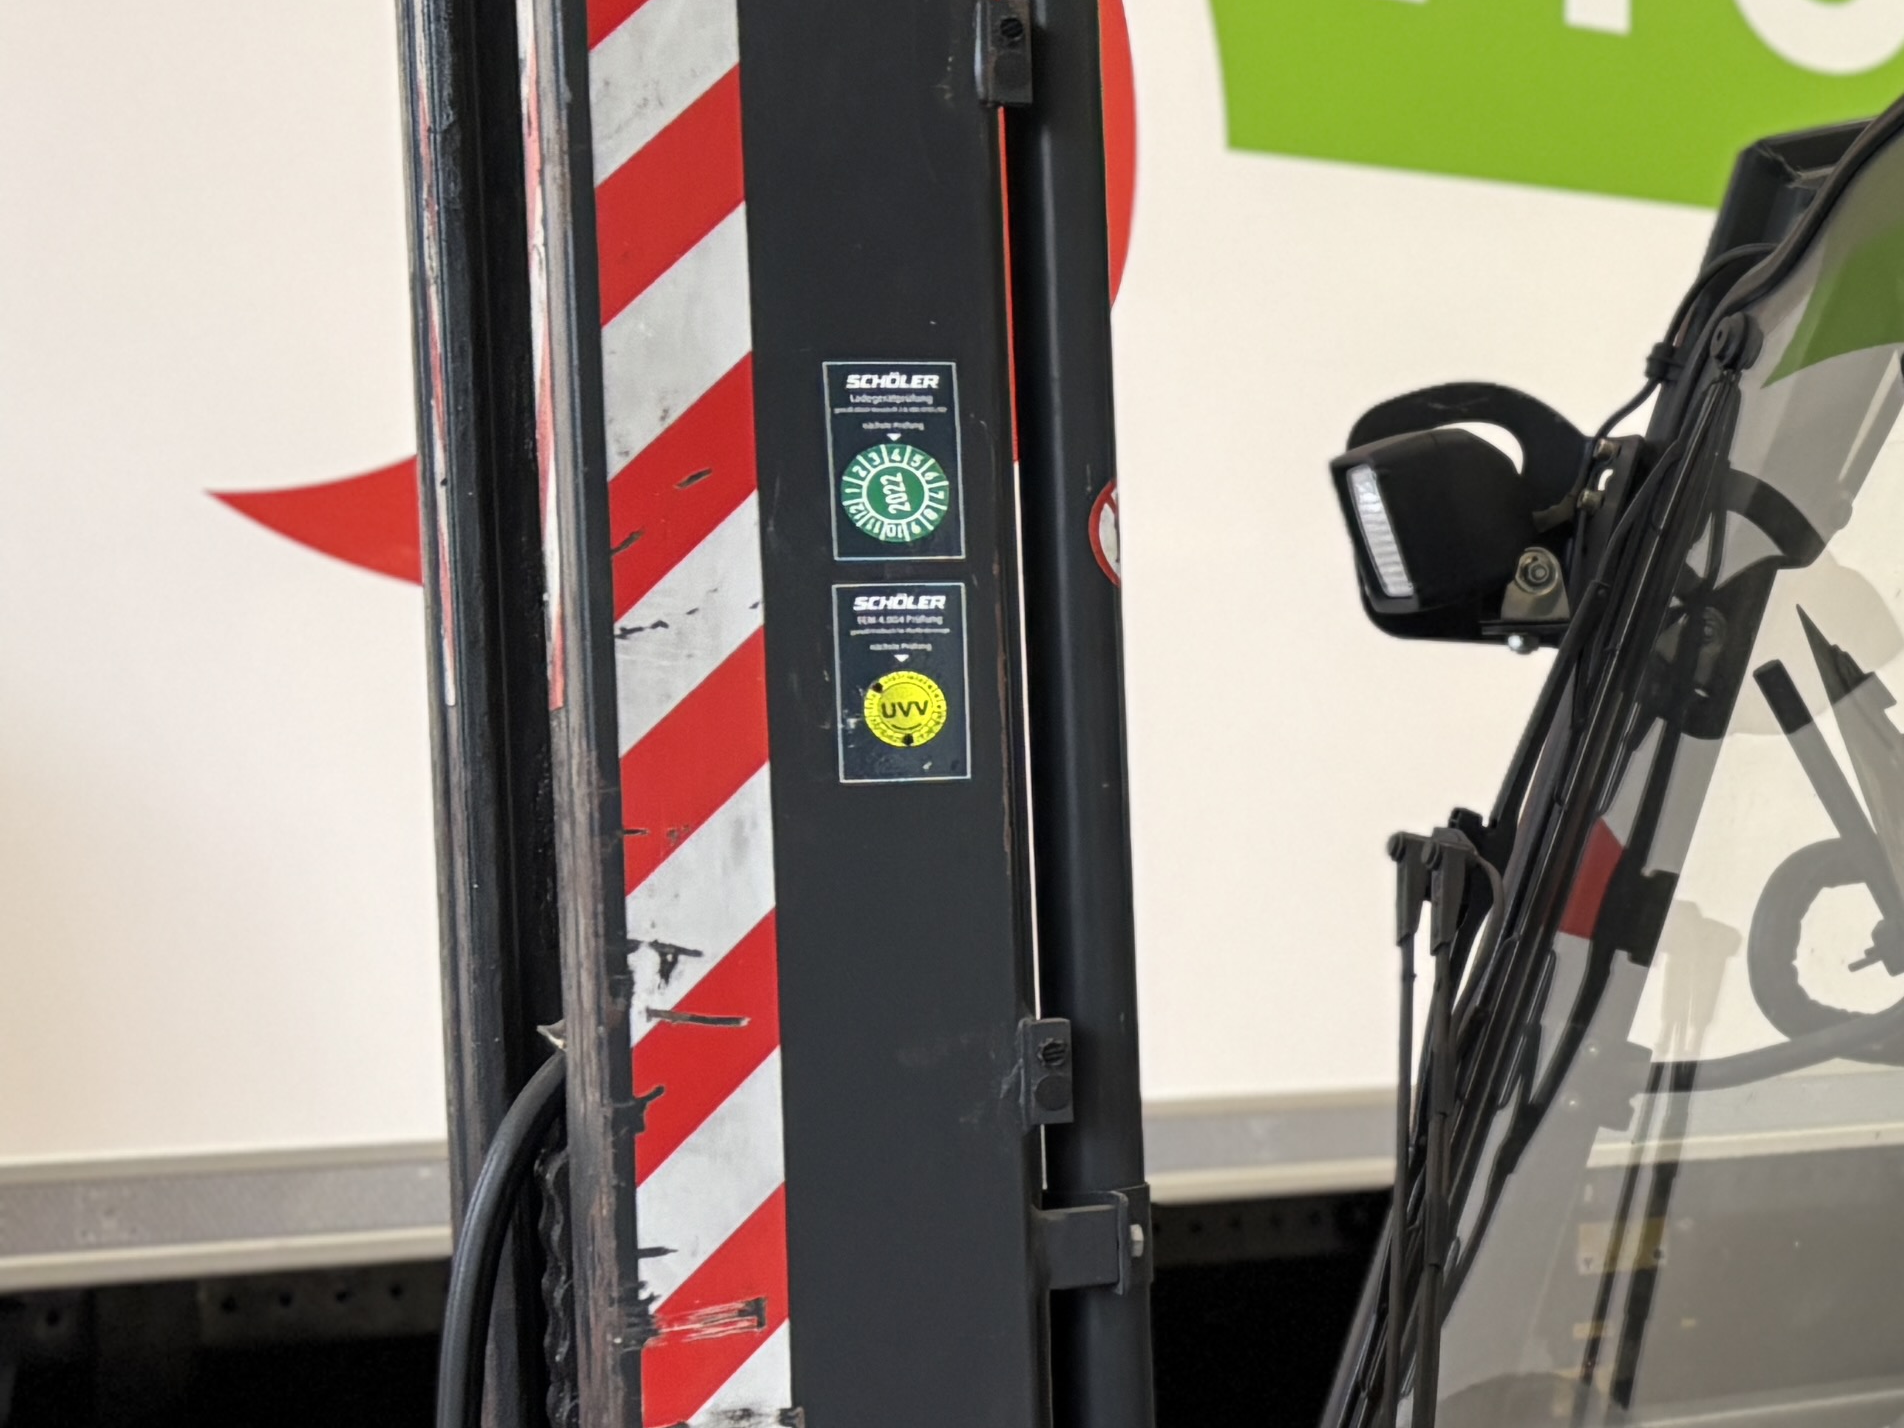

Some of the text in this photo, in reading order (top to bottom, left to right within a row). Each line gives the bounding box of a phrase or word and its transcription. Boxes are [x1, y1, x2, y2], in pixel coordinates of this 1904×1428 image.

[845, 371, 939, 389] SCHÖLER
[880, 472, 911, 514] 2022
[853, 593, 946, 611] SCHÖLER
[881, 699, 928, 719] UVV
